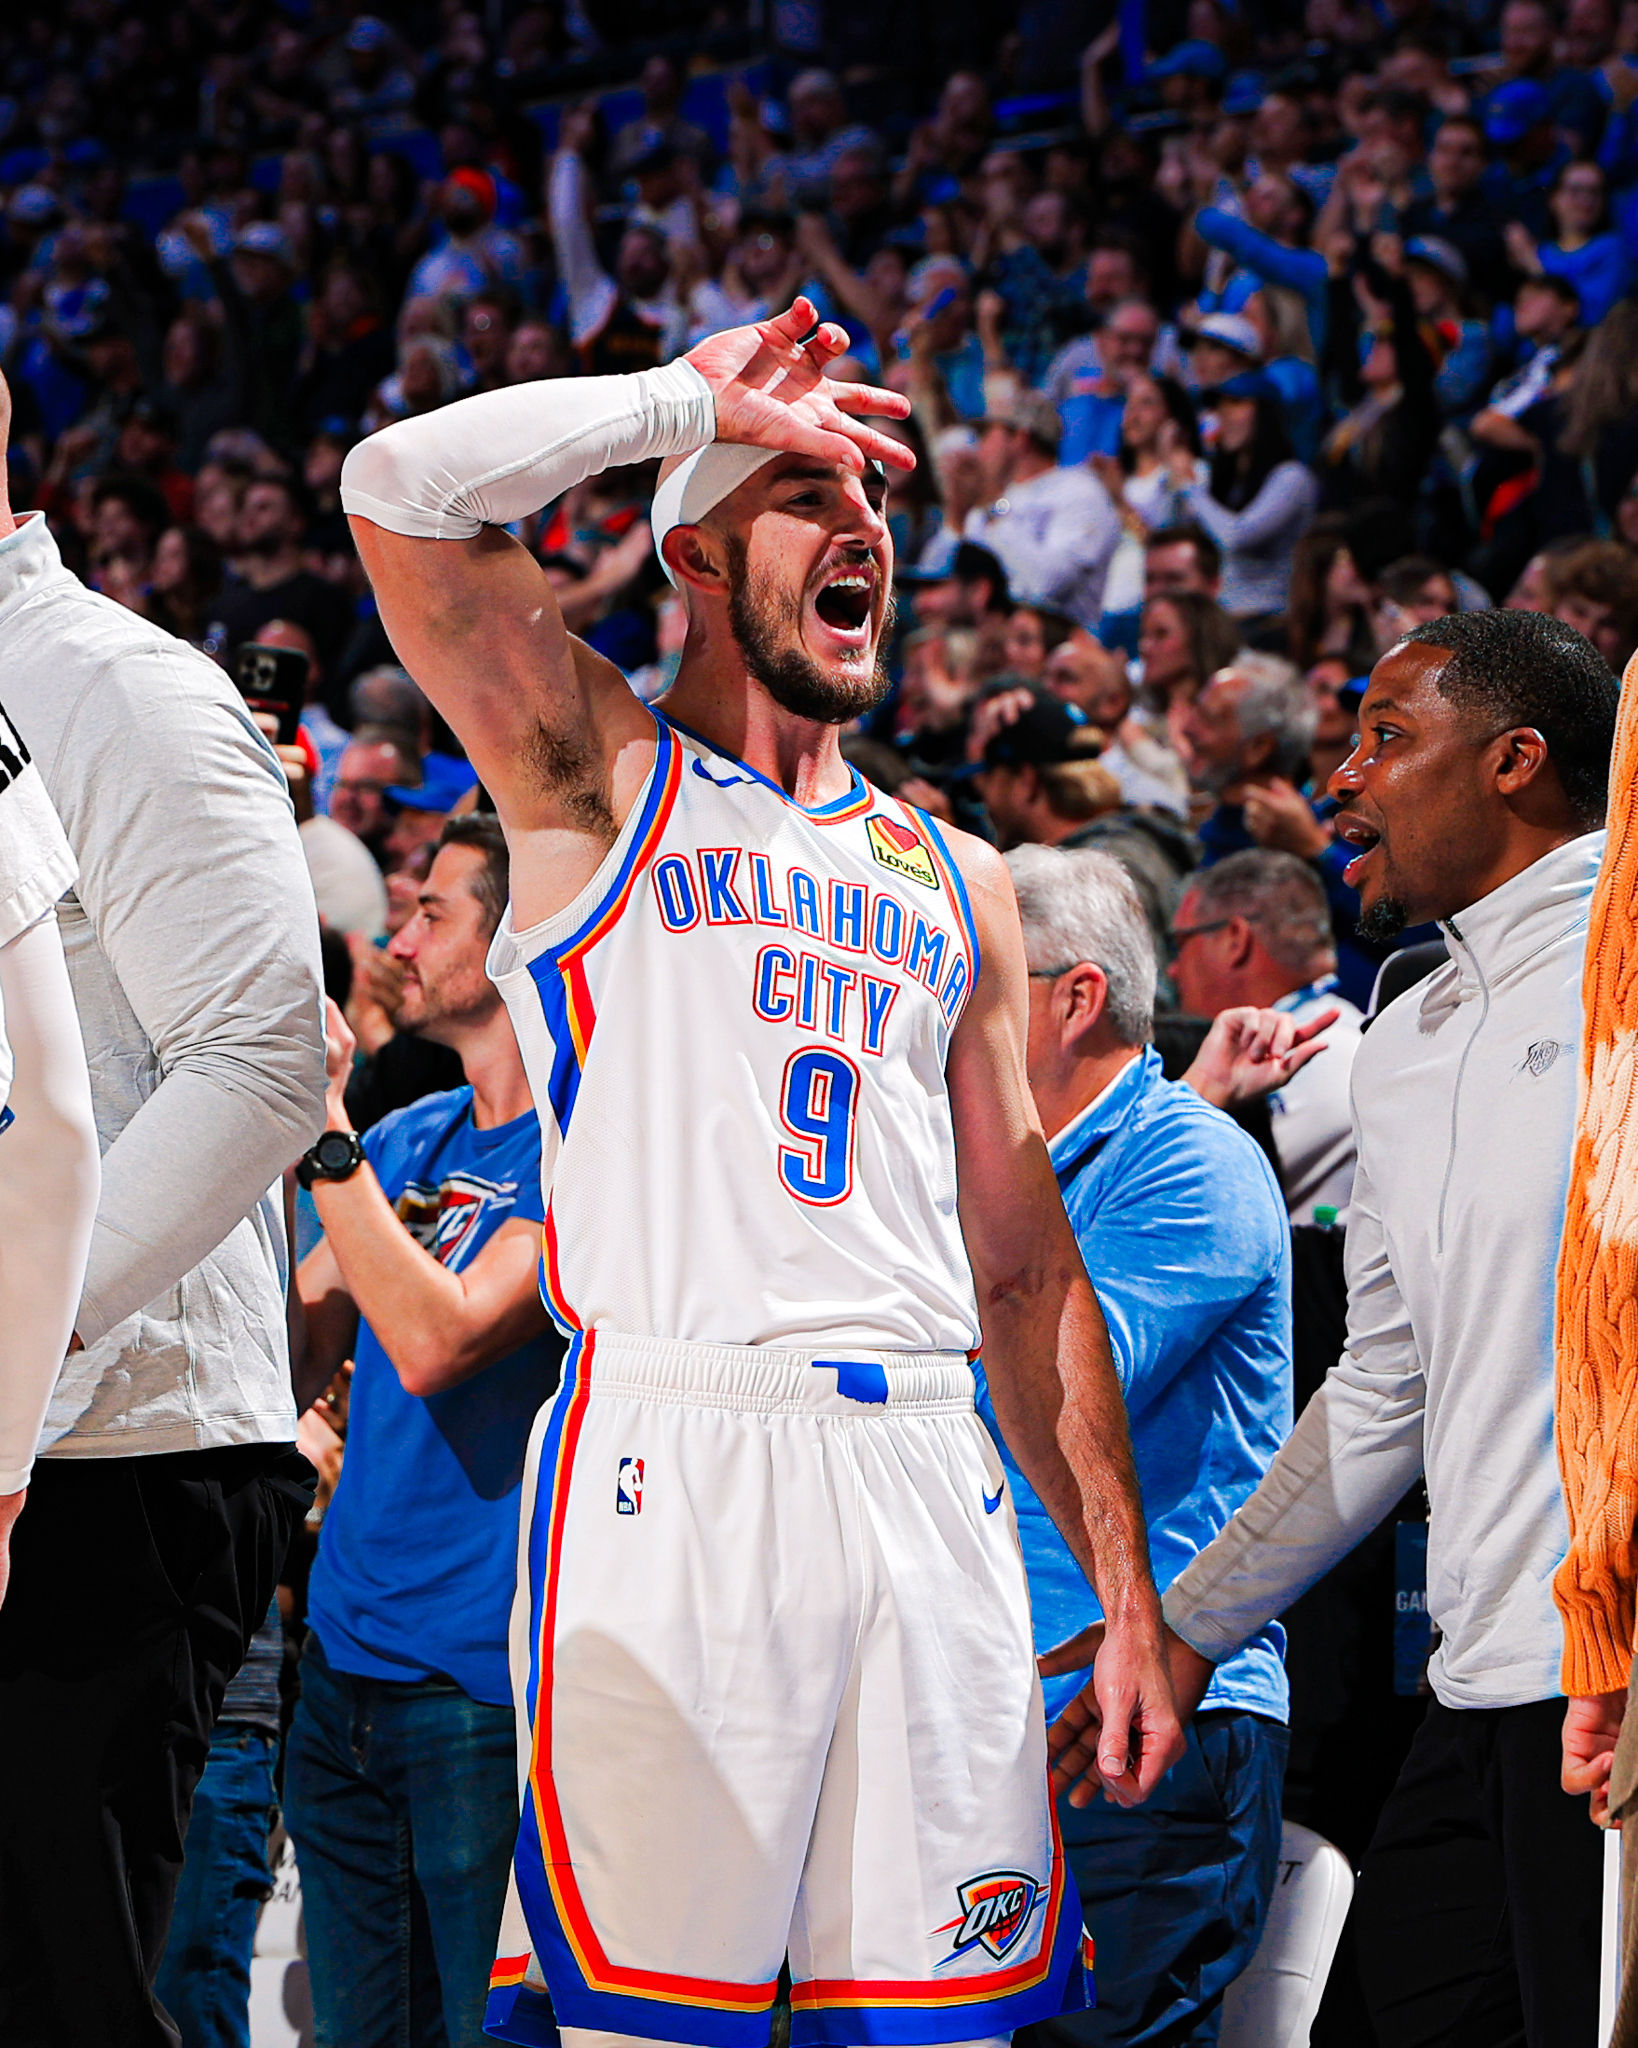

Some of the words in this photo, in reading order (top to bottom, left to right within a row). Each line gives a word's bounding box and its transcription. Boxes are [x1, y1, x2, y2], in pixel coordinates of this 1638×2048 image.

[651, 847, 972, 1030] OKLAHOMA
[753, 943, 900, 1057] CITY
[777, 1045, 861, 1208] 9
[954, 1887, 1024, 1945] OKC
